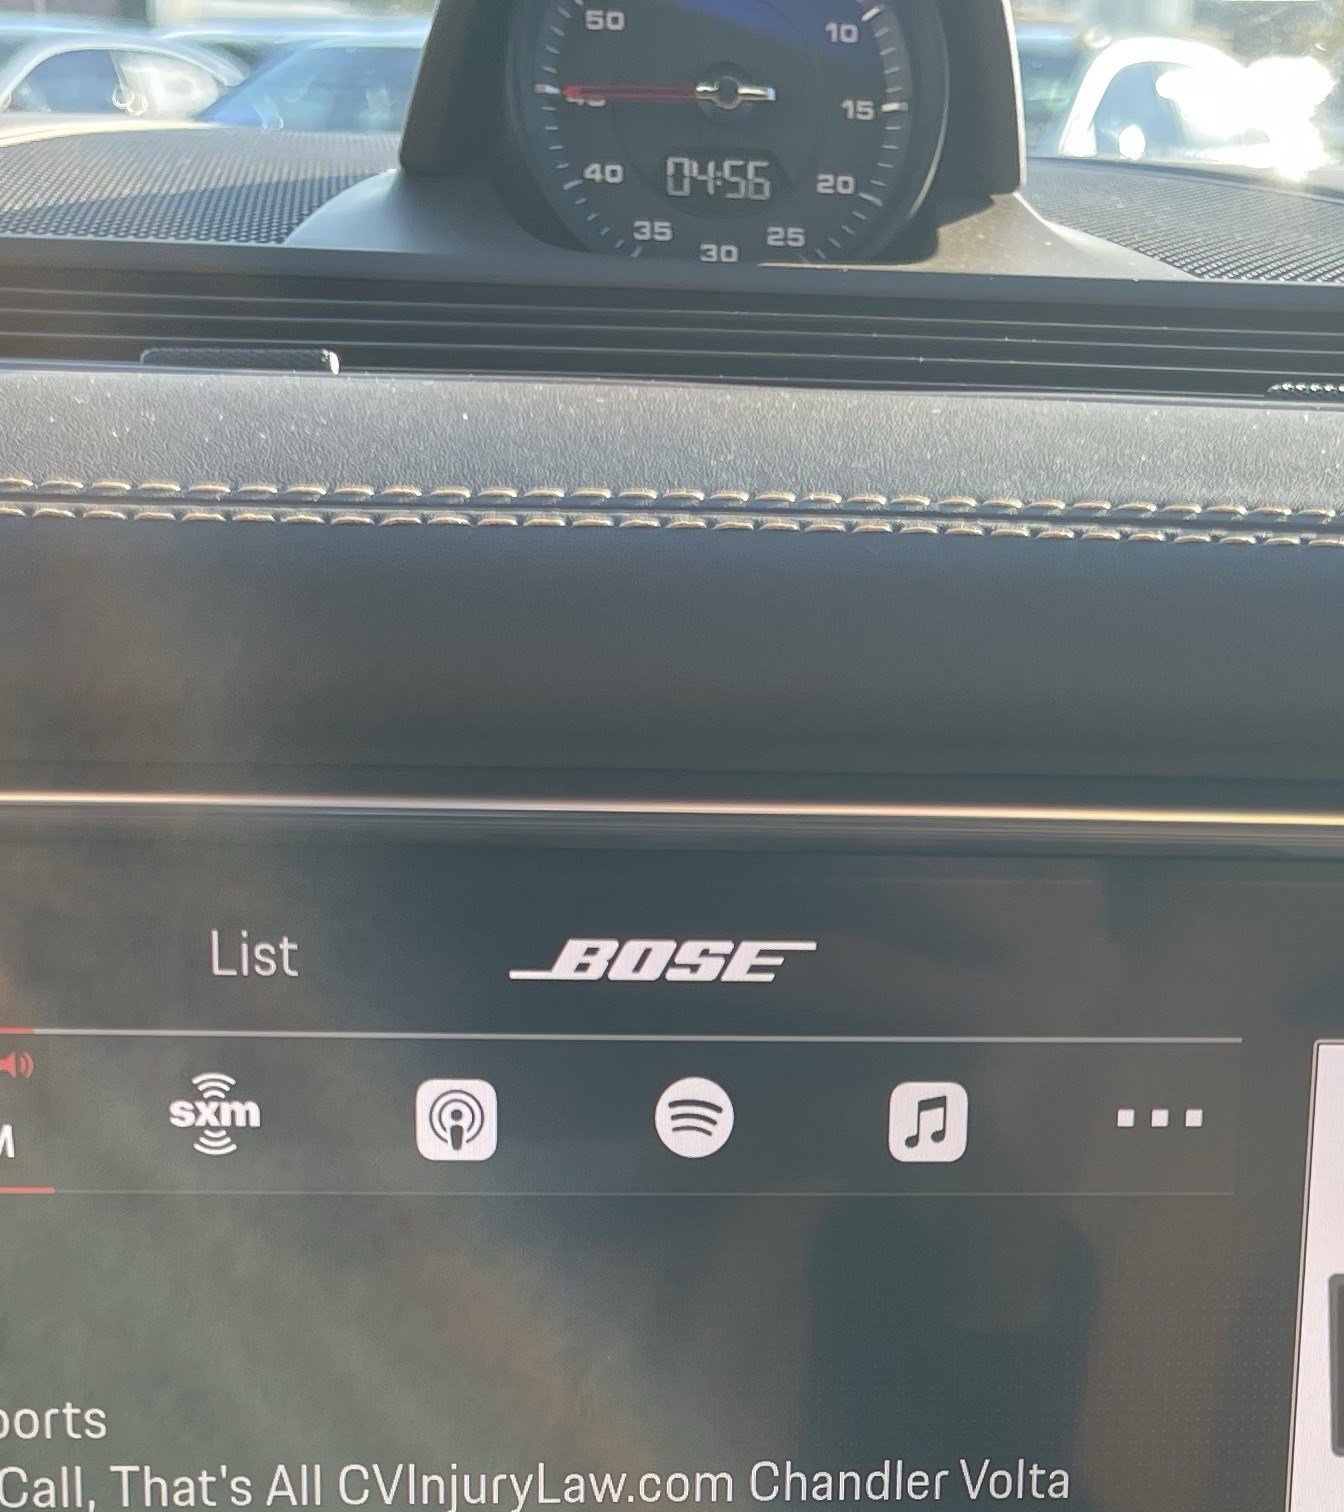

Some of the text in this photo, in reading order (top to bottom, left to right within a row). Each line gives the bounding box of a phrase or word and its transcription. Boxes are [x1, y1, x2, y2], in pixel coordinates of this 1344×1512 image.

[586, 10, 626, 31] 50
[825, 23, 858, 44] 10
[842, 100, 875, 121] 15
[583, 163, 624, 184] 40
[665, 156, 772, 200] 04:56
[816, 175, 855, 195] 20
[633, 221, 673, 242] 35
[766, 227, 806, 248] 25
[700, 243, 740, 263] 30
[211, 930, 299, 978] List
[509, 938, 818, 983] BOSE
[169, 1098, 261, 1129] sxm
[109, 1465, 253, 1508] That's
[266, 1464, 321, 1507] All
[749, 1459, 949, 1503] Chandler
[960, 1458, 1070, 1500] Volta
